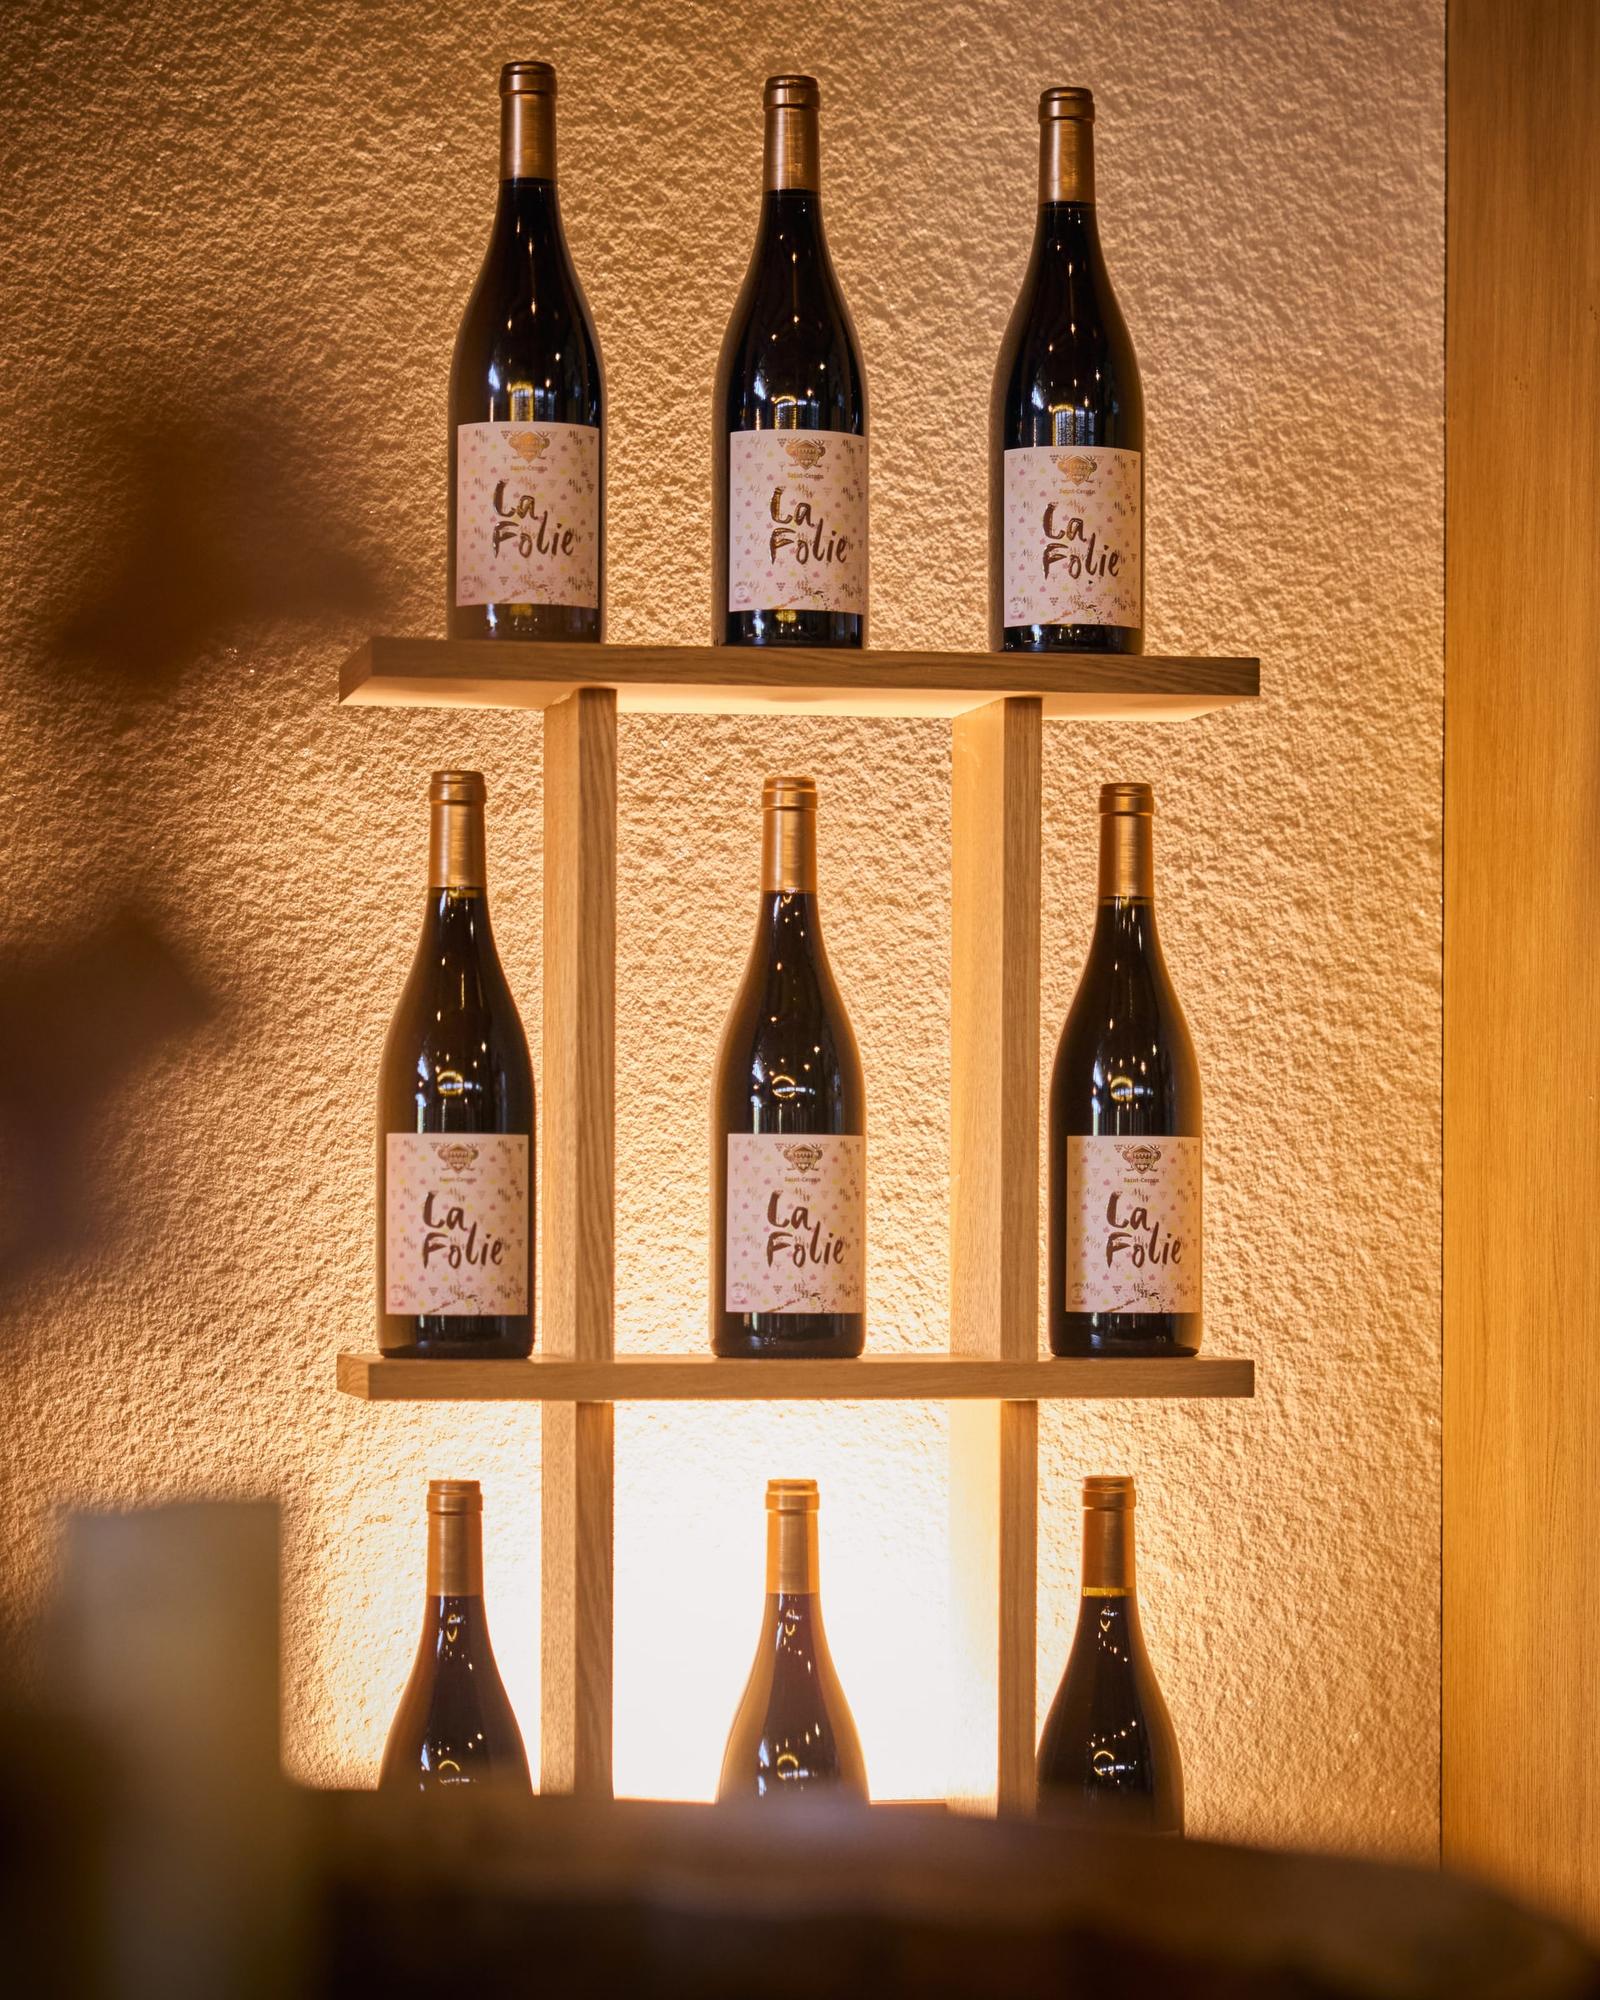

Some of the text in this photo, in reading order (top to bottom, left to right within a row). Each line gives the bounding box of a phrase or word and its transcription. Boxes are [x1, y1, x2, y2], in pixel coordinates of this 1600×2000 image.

[493, 480, 538, 520] La
[770, 486, 815, 529] La
[1043, 503, 1087, 542] La
[493, 511, 574, 559] Folie
[769, 518, 847, 565] Folie
[1043, 532, 1119, 580] Folie
[423, 1191, 469, 1231] La
[767, 1190, 812, 1231] La
[1106, 1190, 1151, 1231] La
[422, 1221, 503, 1269] Folie
[767, 1221, 844, 1268] Folie
[1106, 1221, 1181, 1268] Folie
